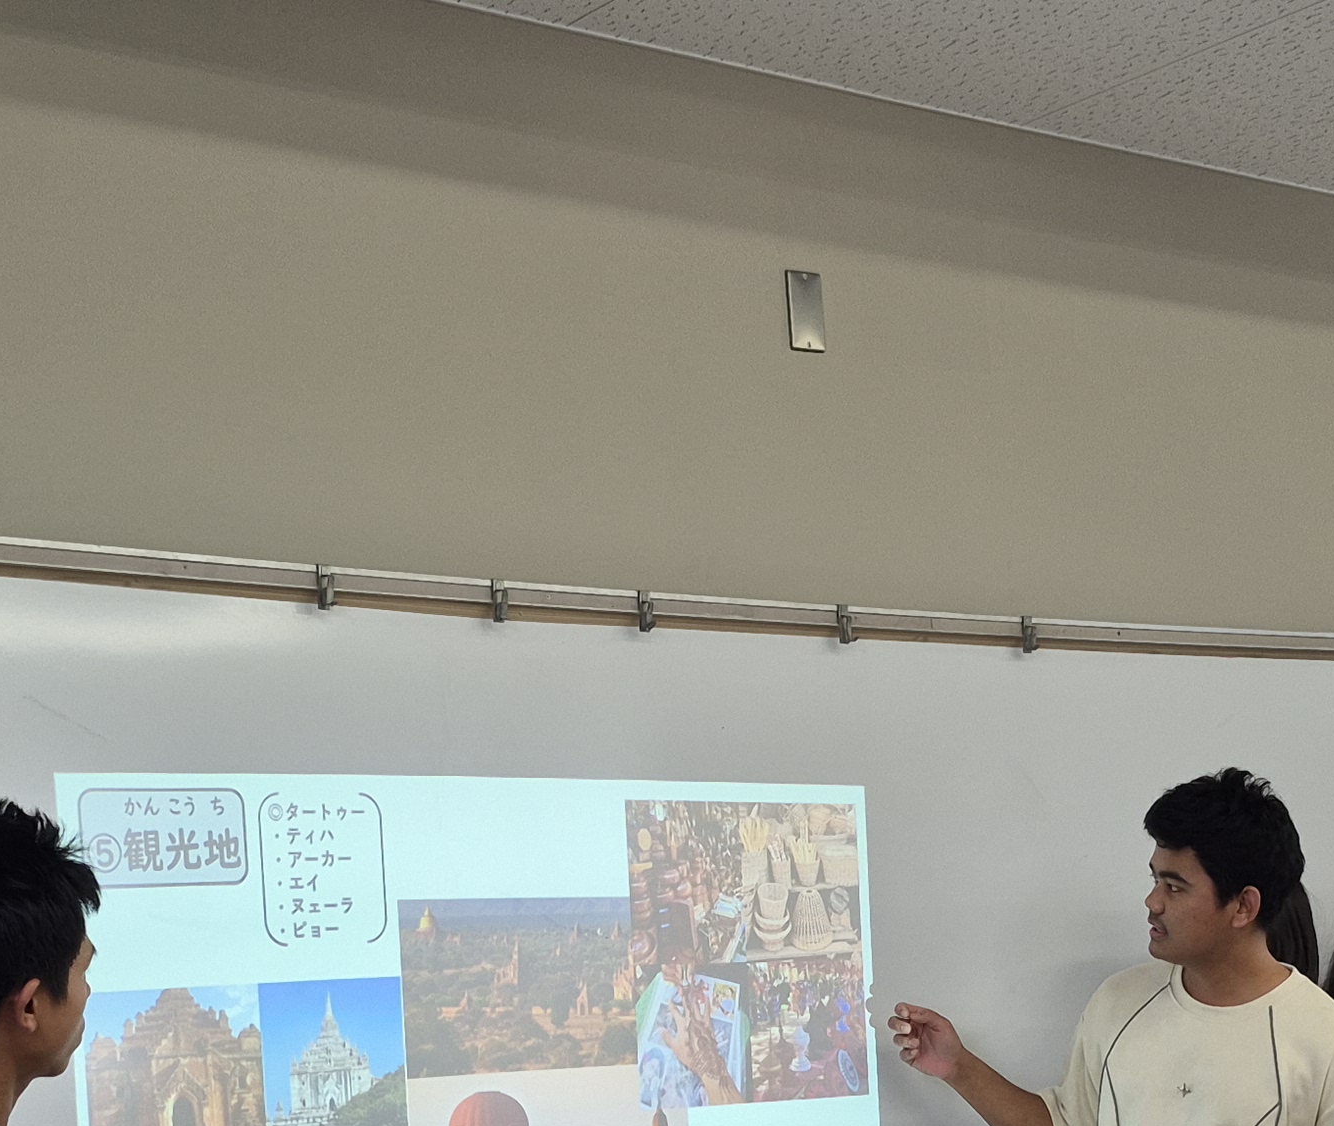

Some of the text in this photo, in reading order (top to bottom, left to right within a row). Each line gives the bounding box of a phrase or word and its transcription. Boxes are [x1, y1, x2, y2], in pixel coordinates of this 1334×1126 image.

[124, 796, 225, 816] かん こう ち
[289, 874, 319, 892] エイ
[293, 921, 340, 938] ピョー
